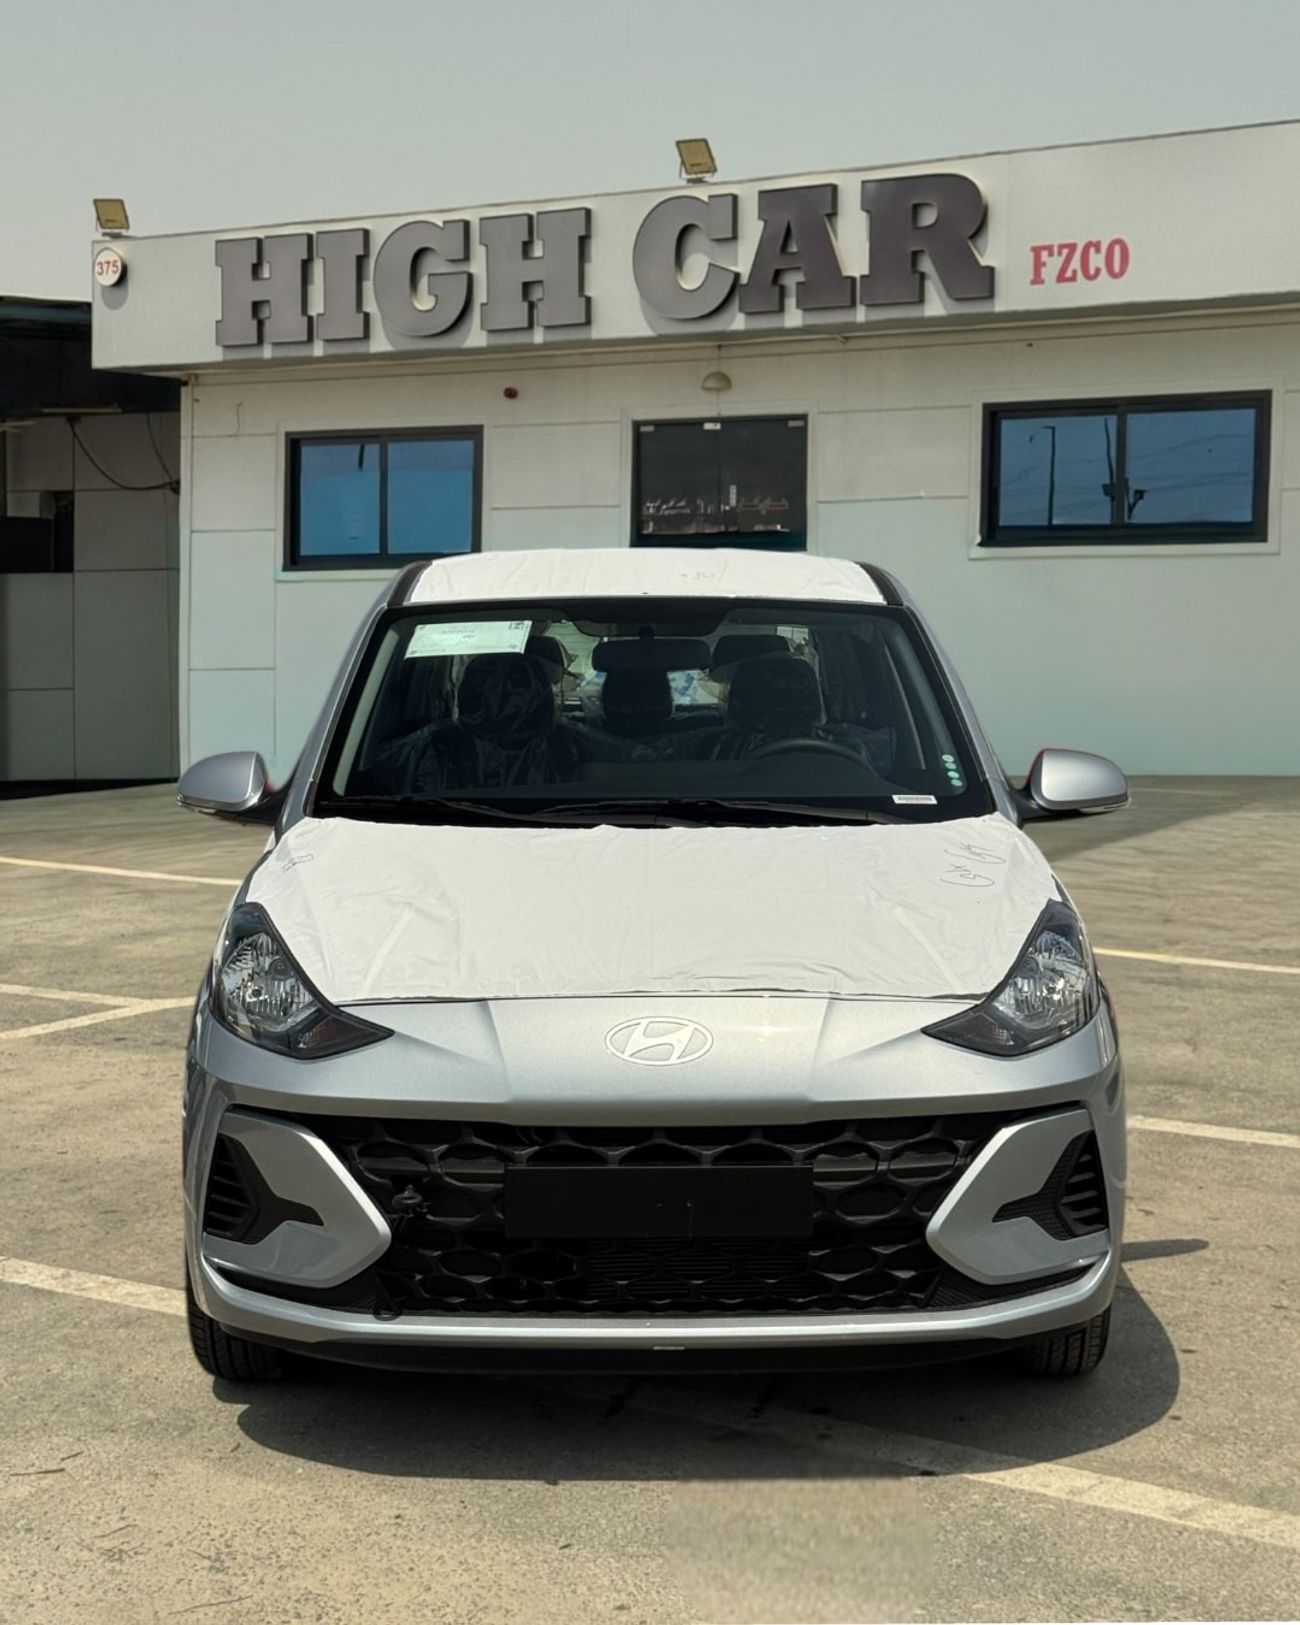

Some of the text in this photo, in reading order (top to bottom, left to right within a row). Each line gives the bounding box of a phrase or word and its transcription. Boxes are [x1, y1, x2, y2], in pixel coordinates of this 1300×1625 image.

[96, 260, 119, 276] 375
[215, 173, 1130, 346] HIGH CAR FZCO
